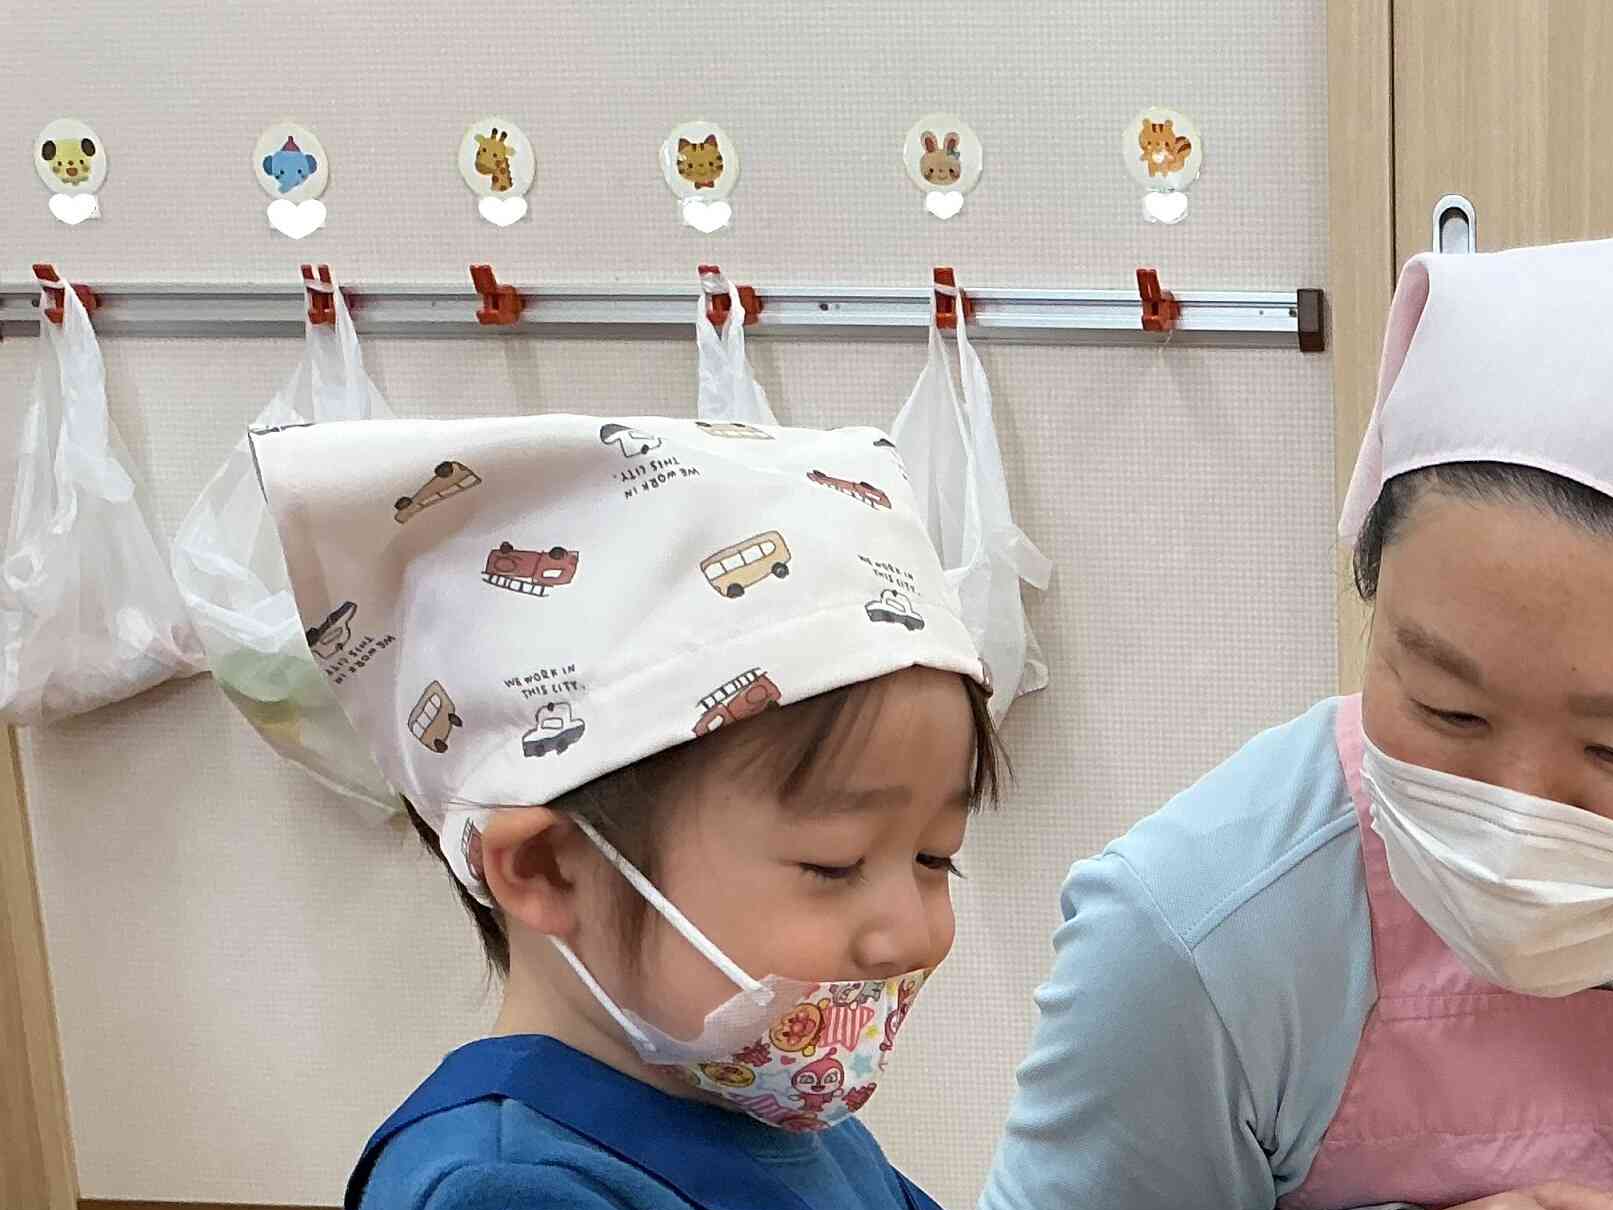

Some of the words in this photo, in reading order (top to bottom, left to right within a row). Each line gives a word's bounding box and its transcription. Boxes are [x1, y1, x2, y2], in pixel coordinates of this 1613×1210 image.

[649, 456, 680, 472] THIS
[678, 466, 700, 477] WE
[641, 469, 676, 490] WORK
[624, 486, 638, 500] IN
[348, 635, 375, 657] THIS
[375, 635, 396, 648] WE
[348, 647, 376, 673] WORK
[503, 677, 522, 688] WE
[524, 669, 559, 684] WORK
[562, 664, 576, 675] IN
[521, 684, 548, 700] THIS
